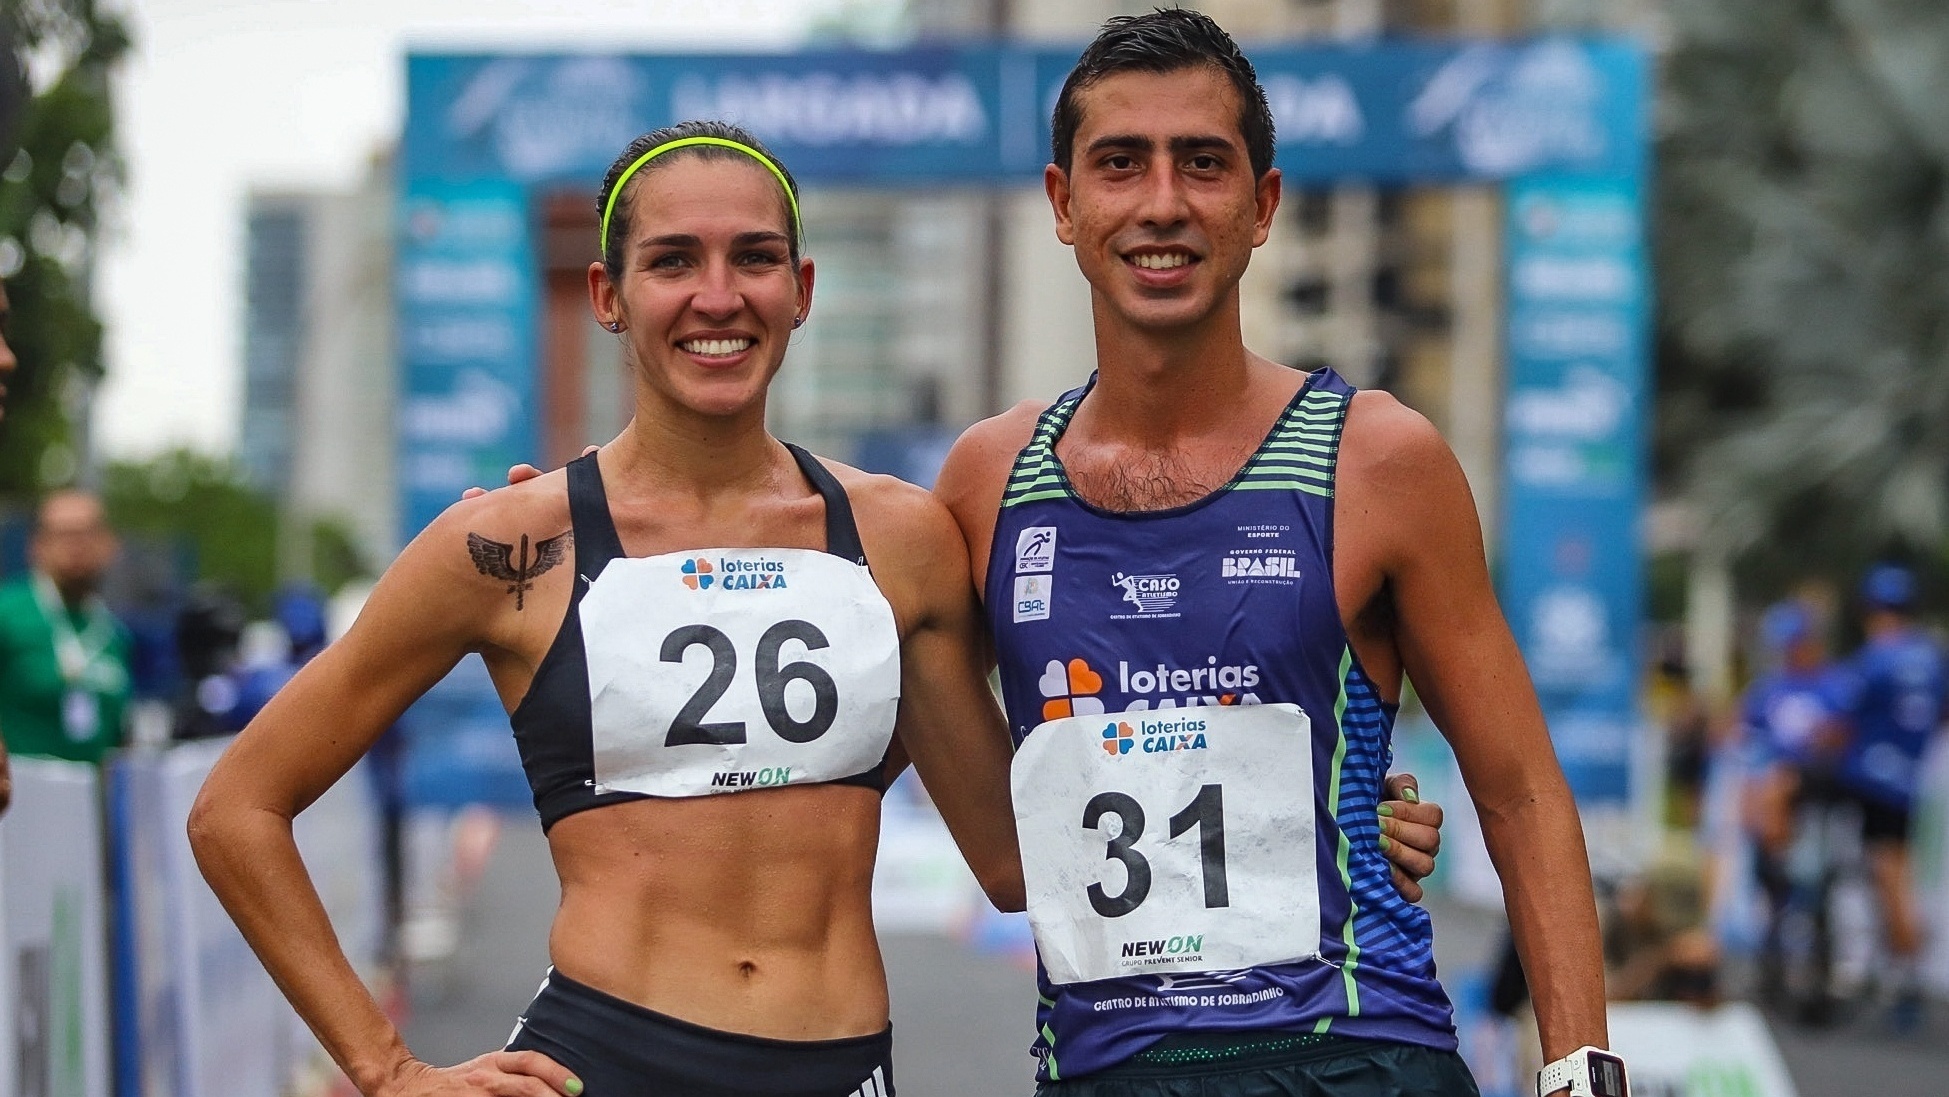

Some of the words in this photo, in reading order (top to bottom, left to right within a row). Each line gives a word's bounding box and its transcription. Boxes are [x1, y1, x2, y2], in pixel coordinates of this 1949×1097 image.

[721, 557, 784, 572] loterias
[1222, 557, 1301, 578] BRASIL
[723, 574, 787, 590] CAIXA
[1138, 578, 1180, 592] CASO
[660, 619, 838, 747] 26
[1120, 656, 1260, 693] loterias
[1141, 717, 1206, 735] loterias
[1143, 733, 1207, 753] CAIXA
[1082, 784, 1229, 918] 31
[1144, 956, 1175, 965] PREVENT
[1094, 998, 1132, 1011] CENTRO
[1135, 997, 1146, 1007] DE
[1200, 996, 1215, 1006] DE
[1218, 987, 1283, 1006] SOBRADINHO
